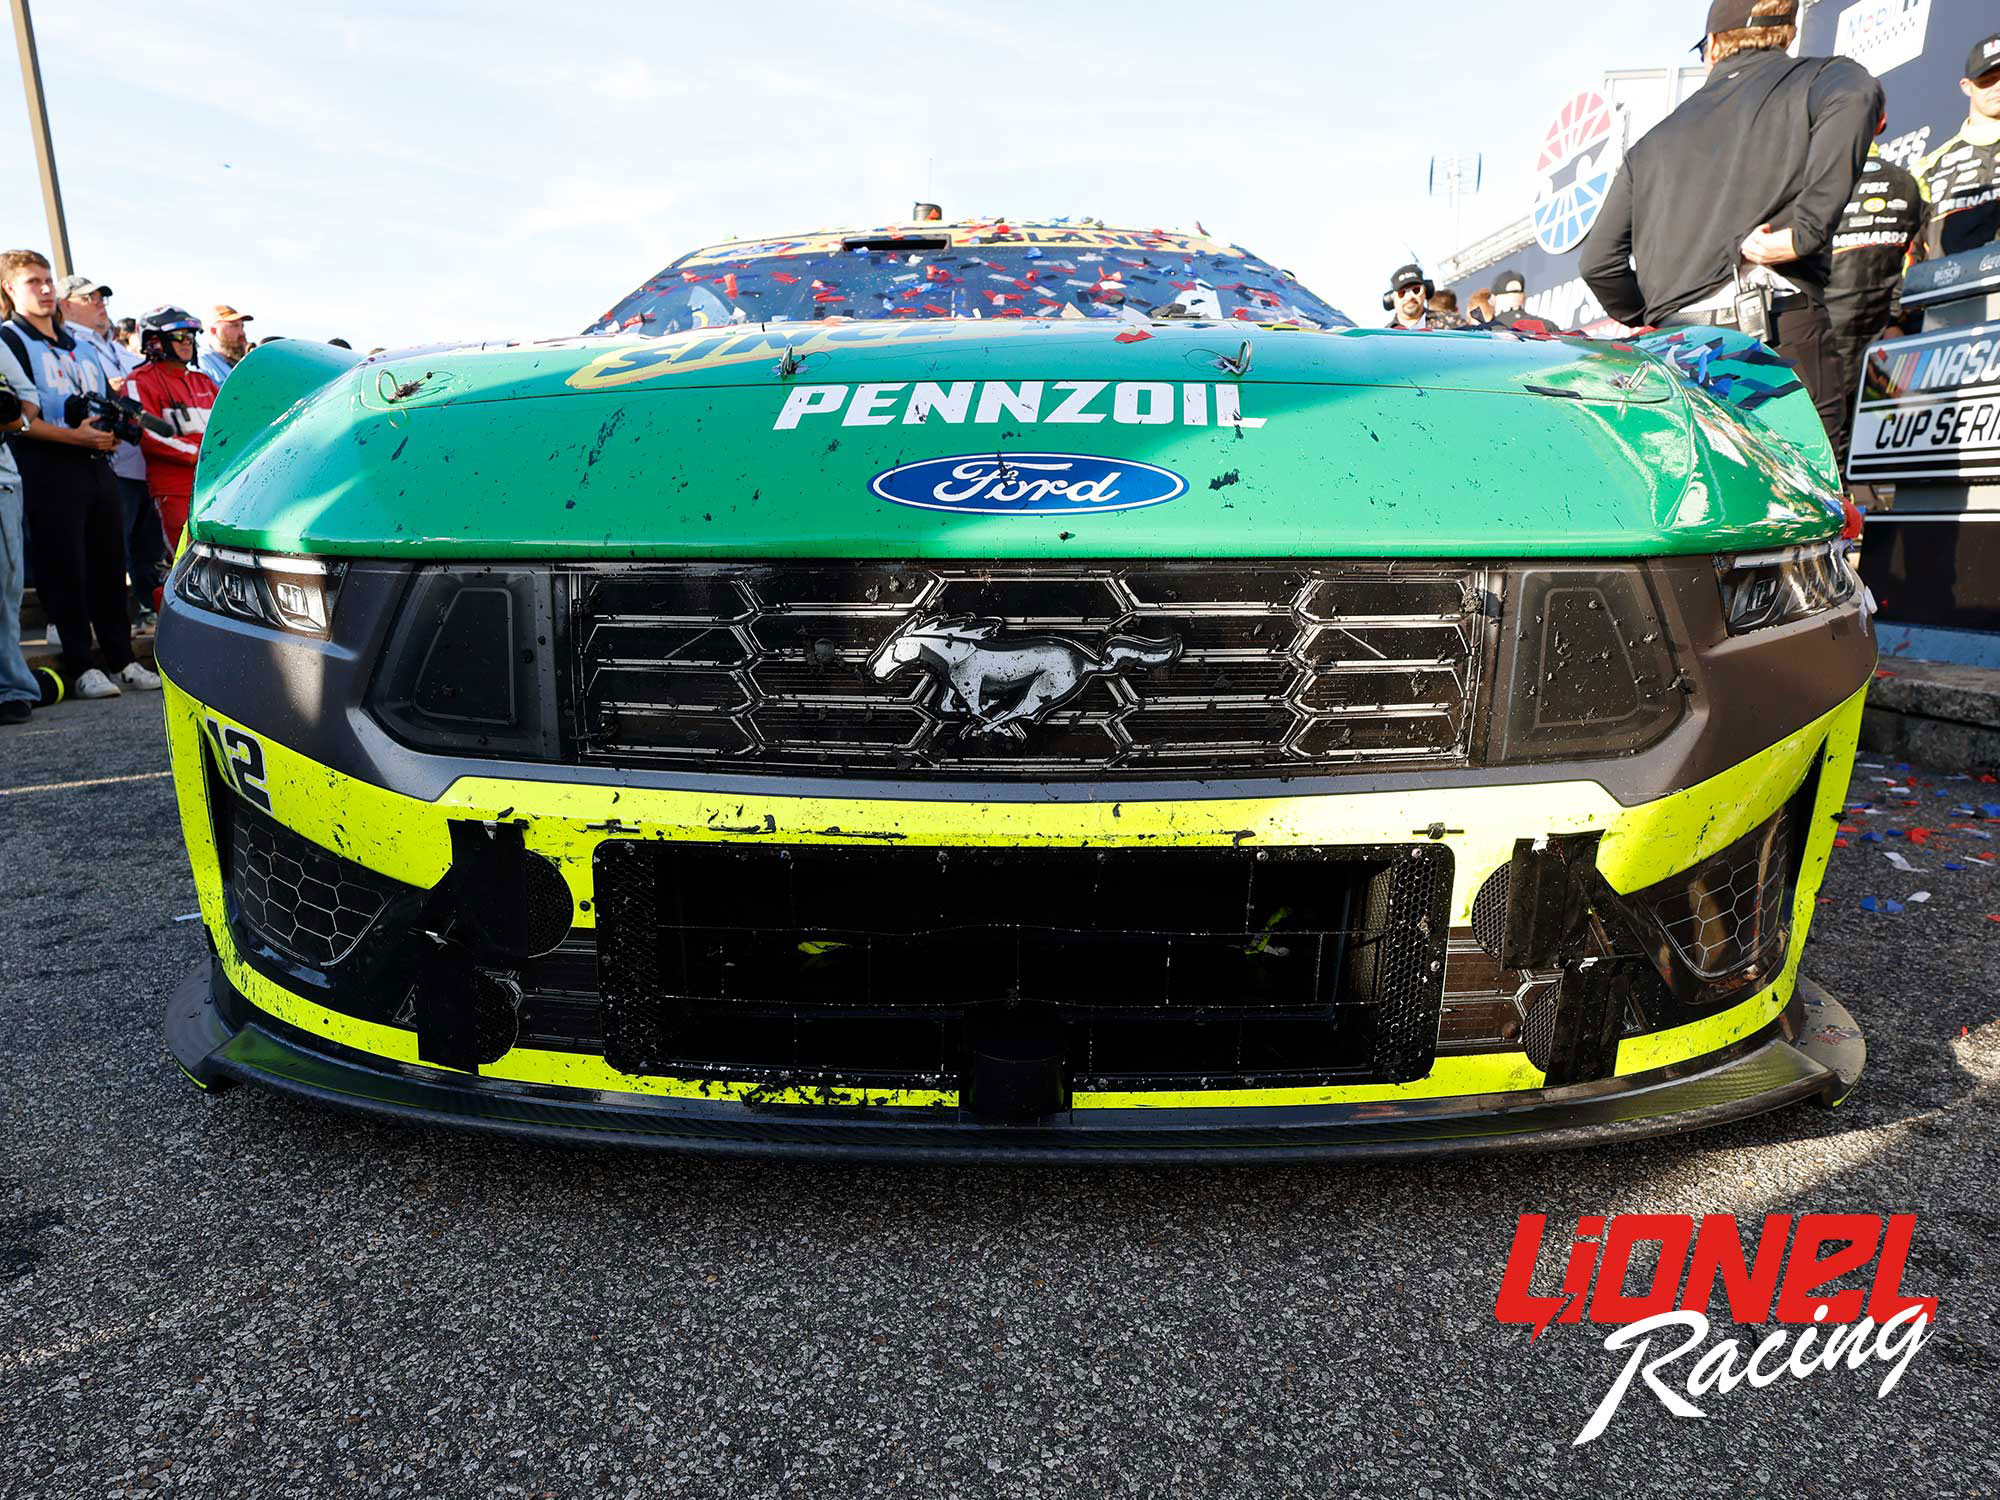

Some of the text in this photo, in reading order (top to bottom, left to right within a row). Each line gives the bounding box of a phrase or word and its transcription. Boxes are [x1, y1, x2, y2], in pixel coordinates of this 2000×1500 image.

[773, 381, 1268, 430] PENNZOIL
[1876, 404, 2000, 449] CUP SERI
